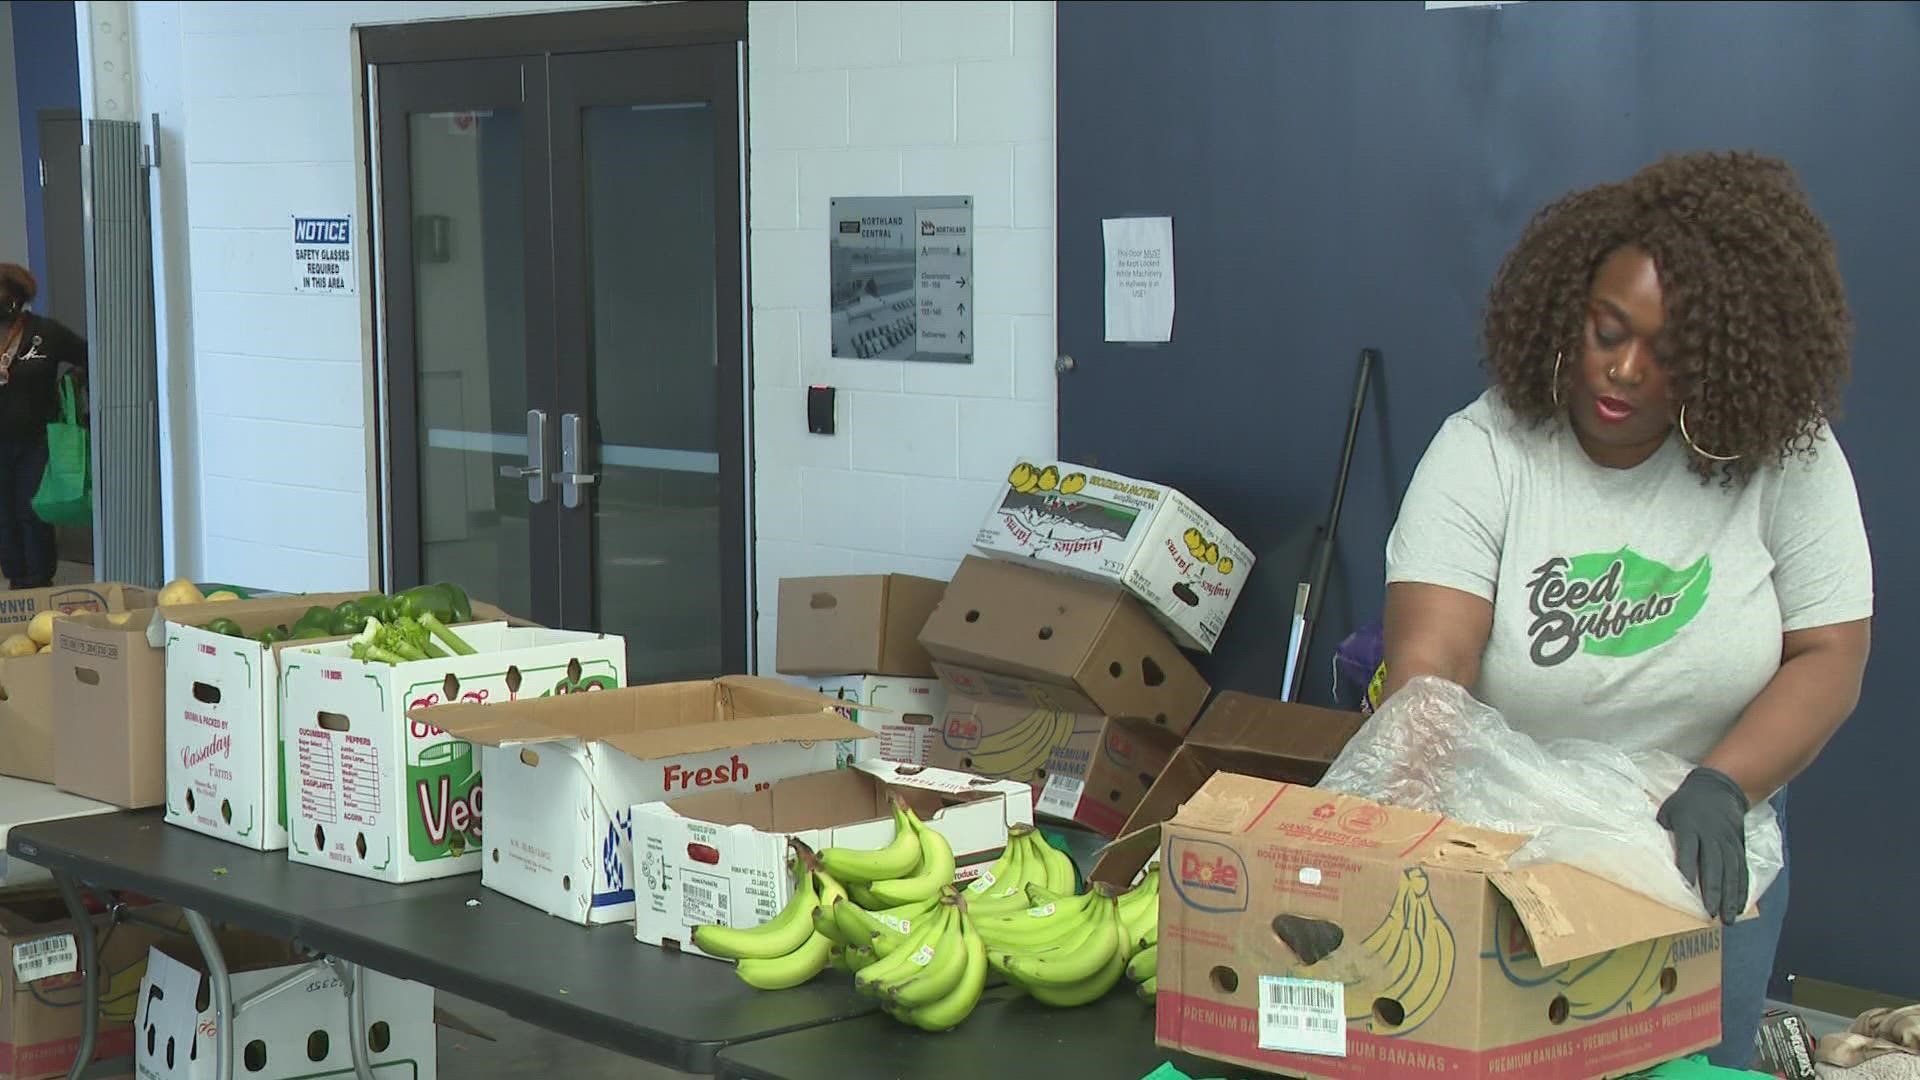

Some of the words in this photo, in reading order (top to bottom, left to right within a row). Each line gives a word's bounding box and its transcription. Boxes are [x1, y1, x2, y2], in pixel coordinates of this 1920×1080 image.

[297, 221, 348, 240] NOTICE
[862, 217, 903, 226] NORTHLAND
[862, 229, 892, 238] CENTRAL
[296, 249, 320, 260] SAFETY
[322, 249, 350, 261] GLASSES
[1144, 249, 1160, 258] MUST
[307, 263, 340, 274] REQUIRED
[303, 277, 310, 288] IN
[312, 277, 326, 288] THIS
[328, 277, 345, 288] AREA
[1113, 493, 1154, 511] Washington
[1004, 515, 1034, 547] farms
[1052, 537, 1104, 558] hughes
[1166, 538, 1194, 576] farms
[1200, 579, 1232, 600] hughes
[1526, 557, 1622, 614] Feed
[1528, 594, 1681, 667] Buffalo
[298, 728, 331, 740] CUCUMBERS
[345, 735, 371, 746] PEPPERS
[180, 734, 231, 769] Cassaday
[1051, 746, 1090, 762] PREMIUM
[209, 763, 232, 781] Farms
[664, 754, 750, 792] Fresh
[1046, 758, 1086, 776] BANANAS
[954, 868, 979, 880] roduce
[1182, 851, 1238, 886] Dole
[1322, 859, 1362, 873] COMPANY
[1671, 929, 1720, 963] BANANAS
[1183, 1006, 1238, 1032] PREMIUM
[1662, 1010, 1692, 1031] PREMIUM
[1583, 1030, 1619, 1052] PREMIUM
[1619, 1018, 1654, 1041] BANANAS
[1378, 1046, 1446, 1072] BANANAS
[1488, 1053, 1534, 1074] PREMIUM
[1532, 1042, 1574, 1066] BANANAS
